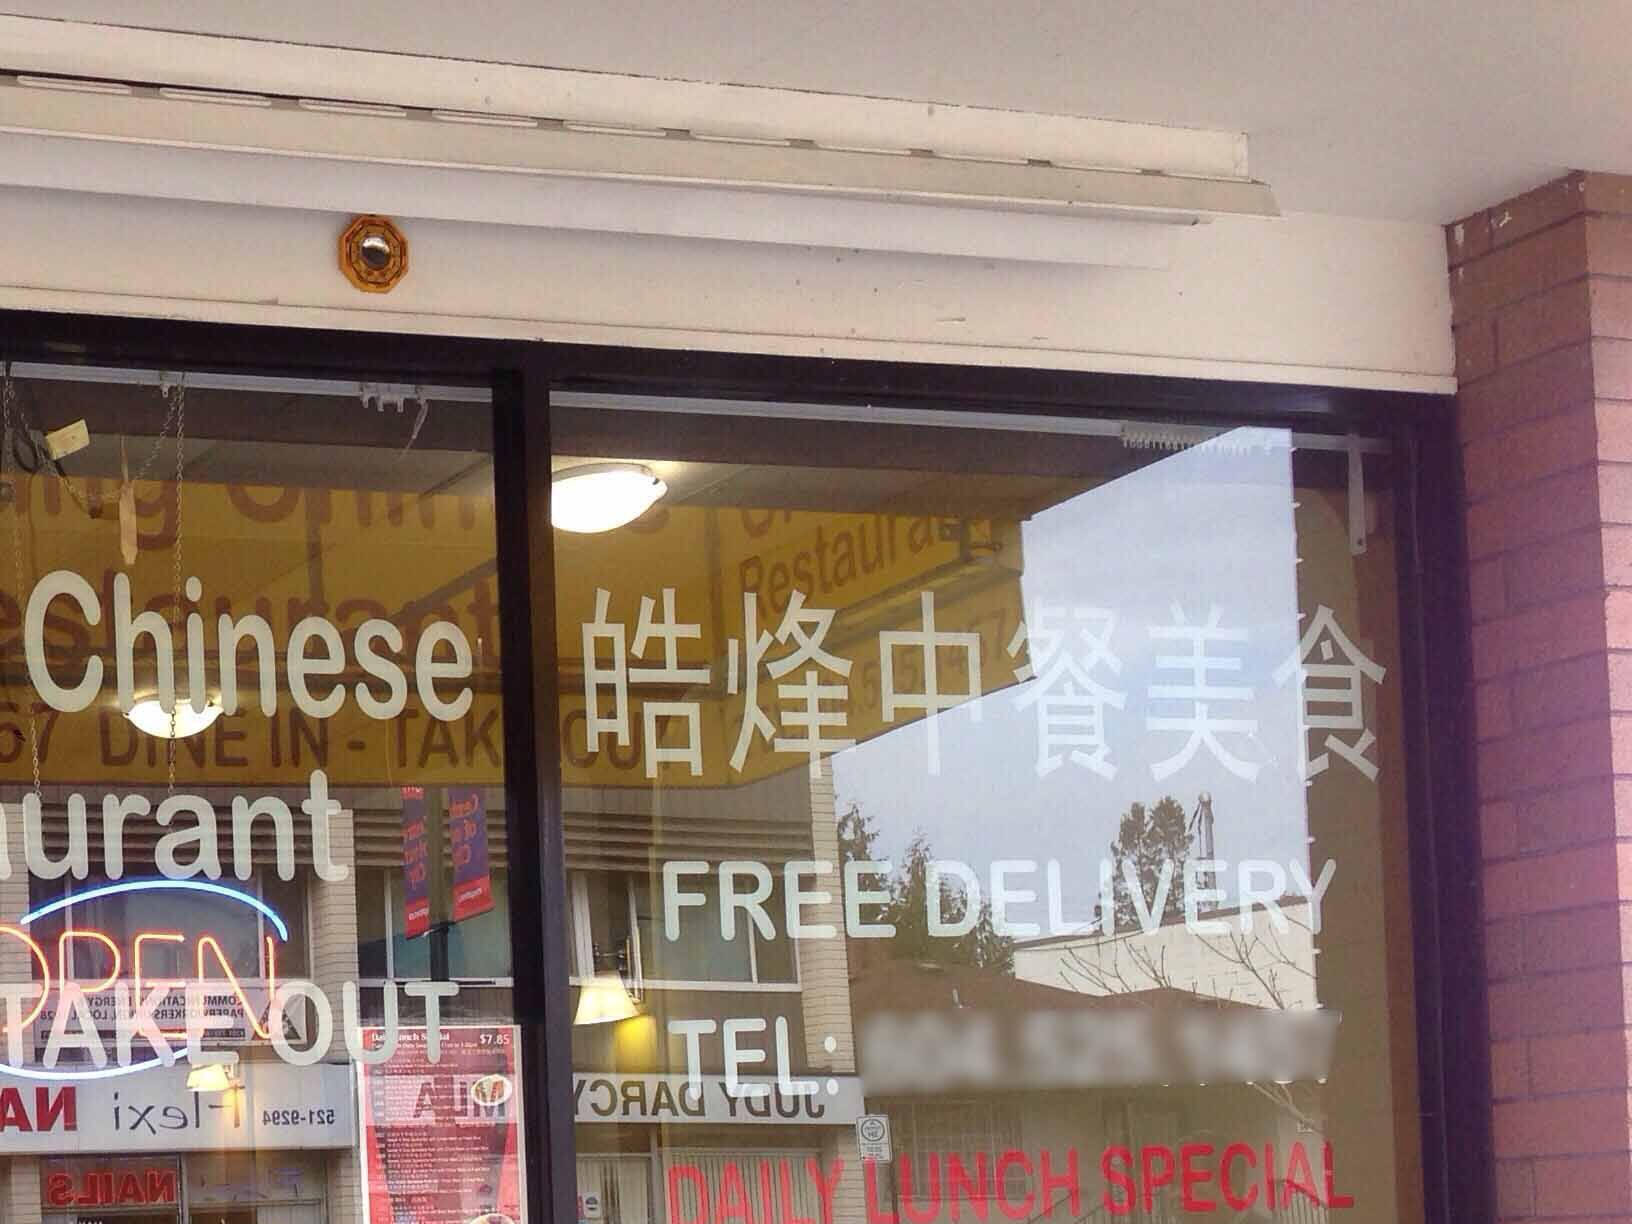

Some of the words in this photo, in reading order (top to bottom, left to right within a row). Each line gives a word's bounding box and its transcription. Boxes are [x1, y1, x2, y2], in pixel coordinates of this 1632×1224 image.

[24, 570, 473, 722] Chinese
[272, 709, 329, 768] IN
[392, 707, 504, 768] TAK
[663, 858, 897, 942] FREE
[926, 858, 1336, 939] DELIVERY
[268, 980, 460, 1067] OUT
[479, 1033, 511, 1045] $7.85
[667, 1016, 839, 1101] TEL:
[1101, 1140, 1354, 1217] SPECIAL
